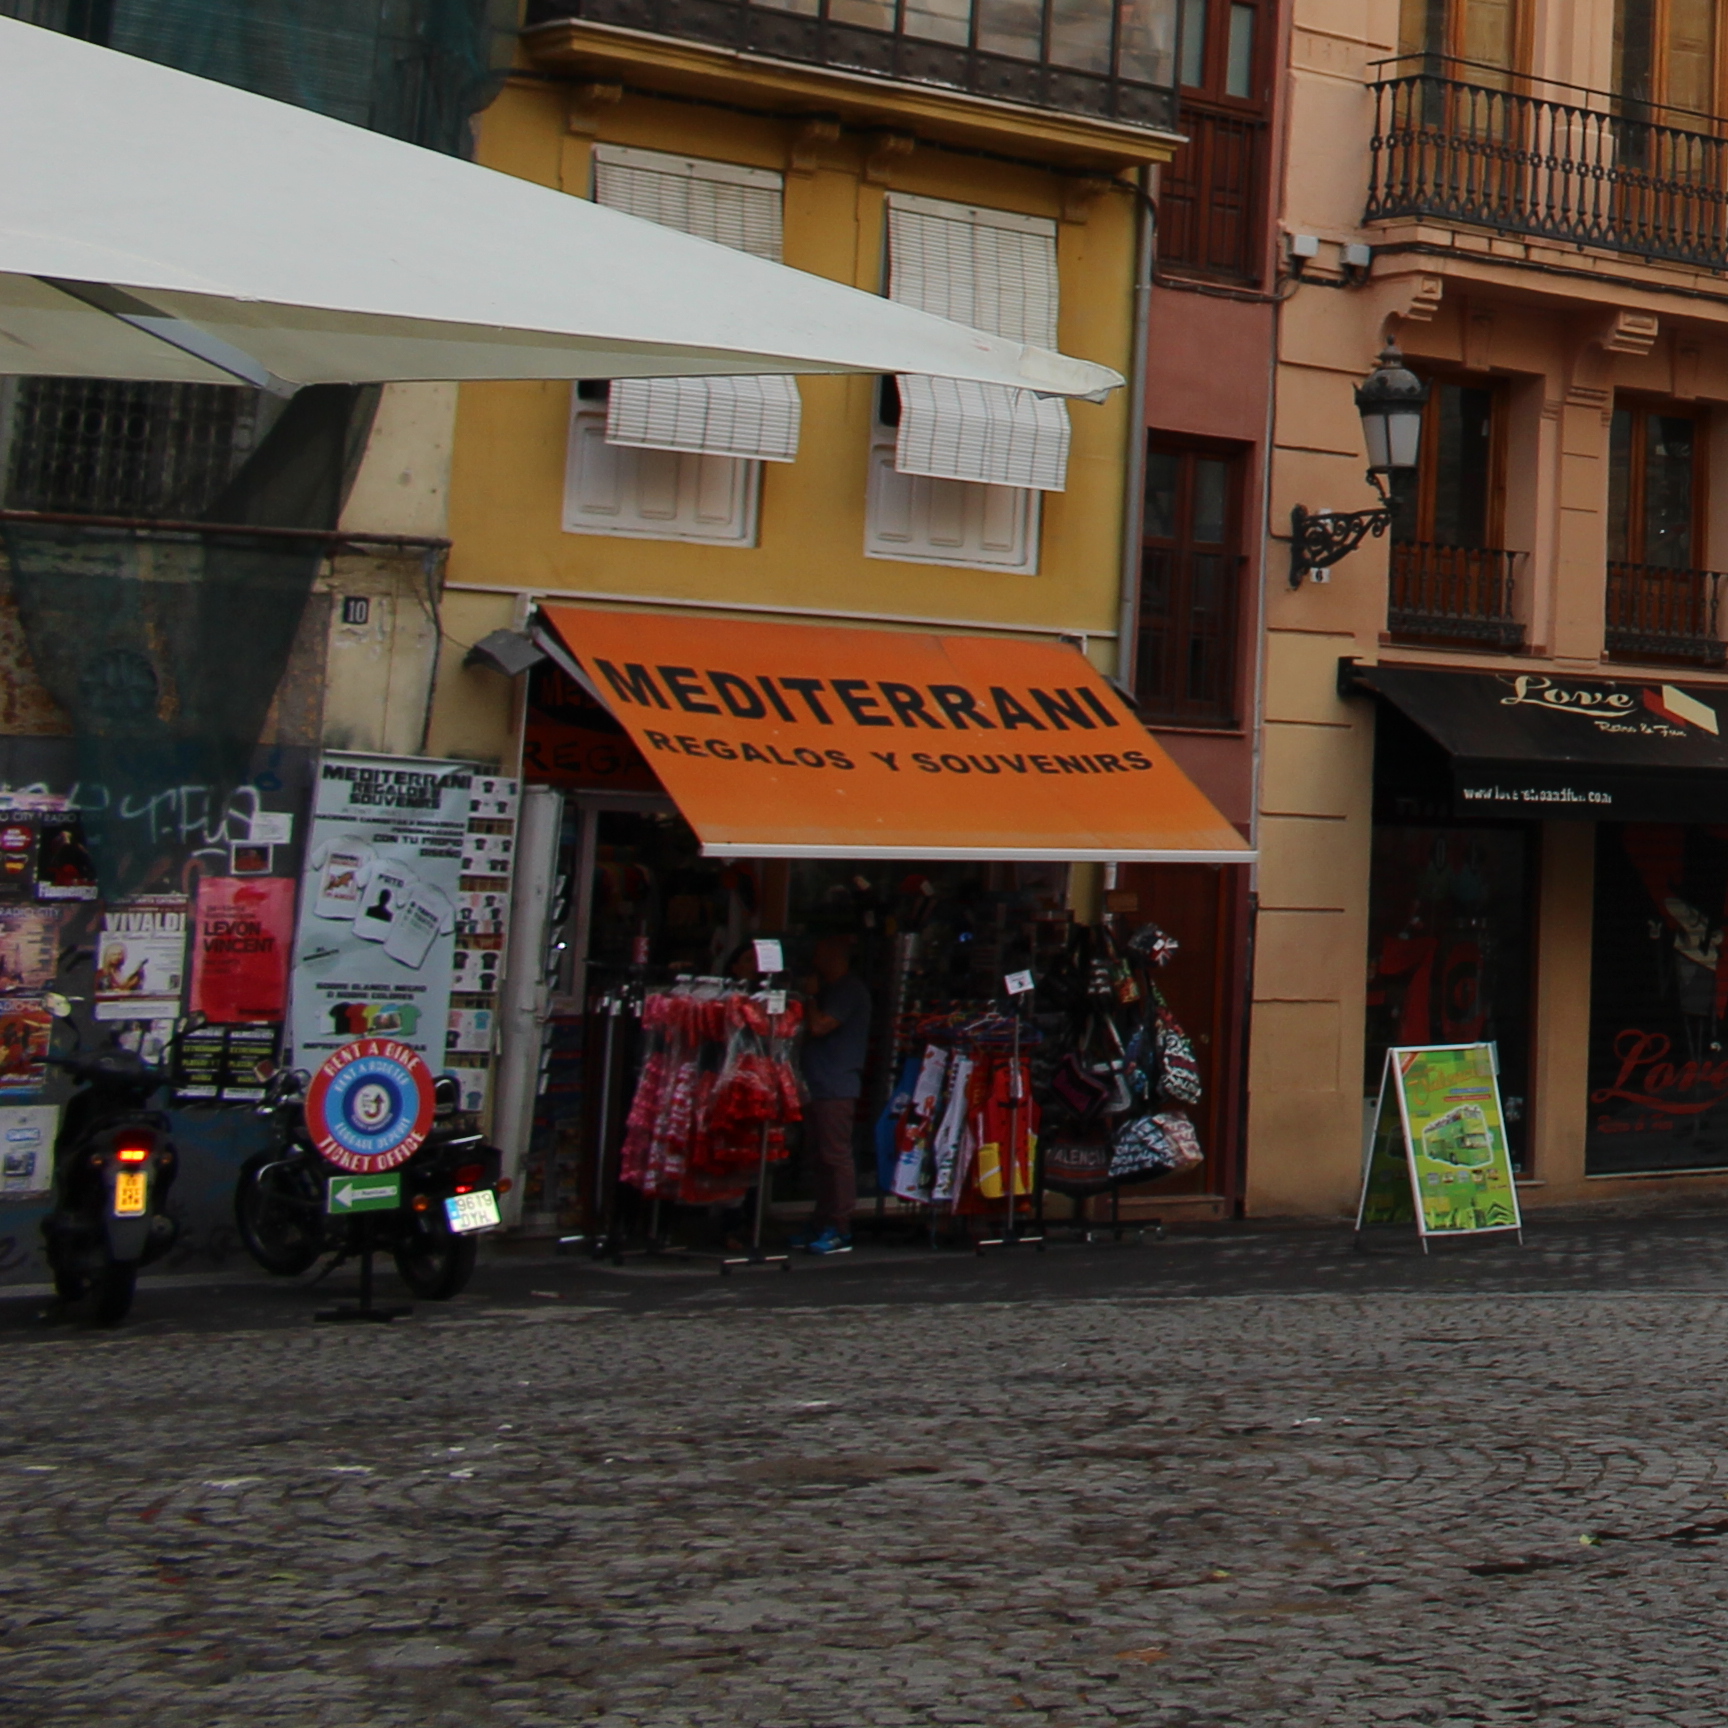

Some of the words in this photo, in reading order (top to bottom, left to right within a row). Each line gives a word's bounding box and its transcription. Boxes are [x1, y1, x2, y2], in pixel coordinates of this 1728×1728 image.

[348, 600, 367, 623] 10
[593, 657, 1120, 731] MEDITERRANI
[1496, 673, 1638, 718] Love
[644, 729, 856, 770] REGALOS
[869, 752, 900, 771] Y
[912, 751, 1154, 774] SOUVENIRS
[322, 765, 472, 789] MEDITERRANI
[352, 782, 428, 797] REGALOS
[350, 793, 441, 808] SOUVENIRS
[402, 835, 419, 844] TU
[104, 912, 186, 932] VIVALDI
[203, 921, 262, 936] LEVON
[203, 938, 275, 953] VINCENT
[323, 1042, 362, 1077] RENT
[367, 1041, 380, 1055] A
[384, 1042, 421, 1071] BIKE
[317, 1134, 372, 1171] TICKET
[377, 1130, 426, 1170] OFFICE
[457, 1192, 492, 1211] 9619
